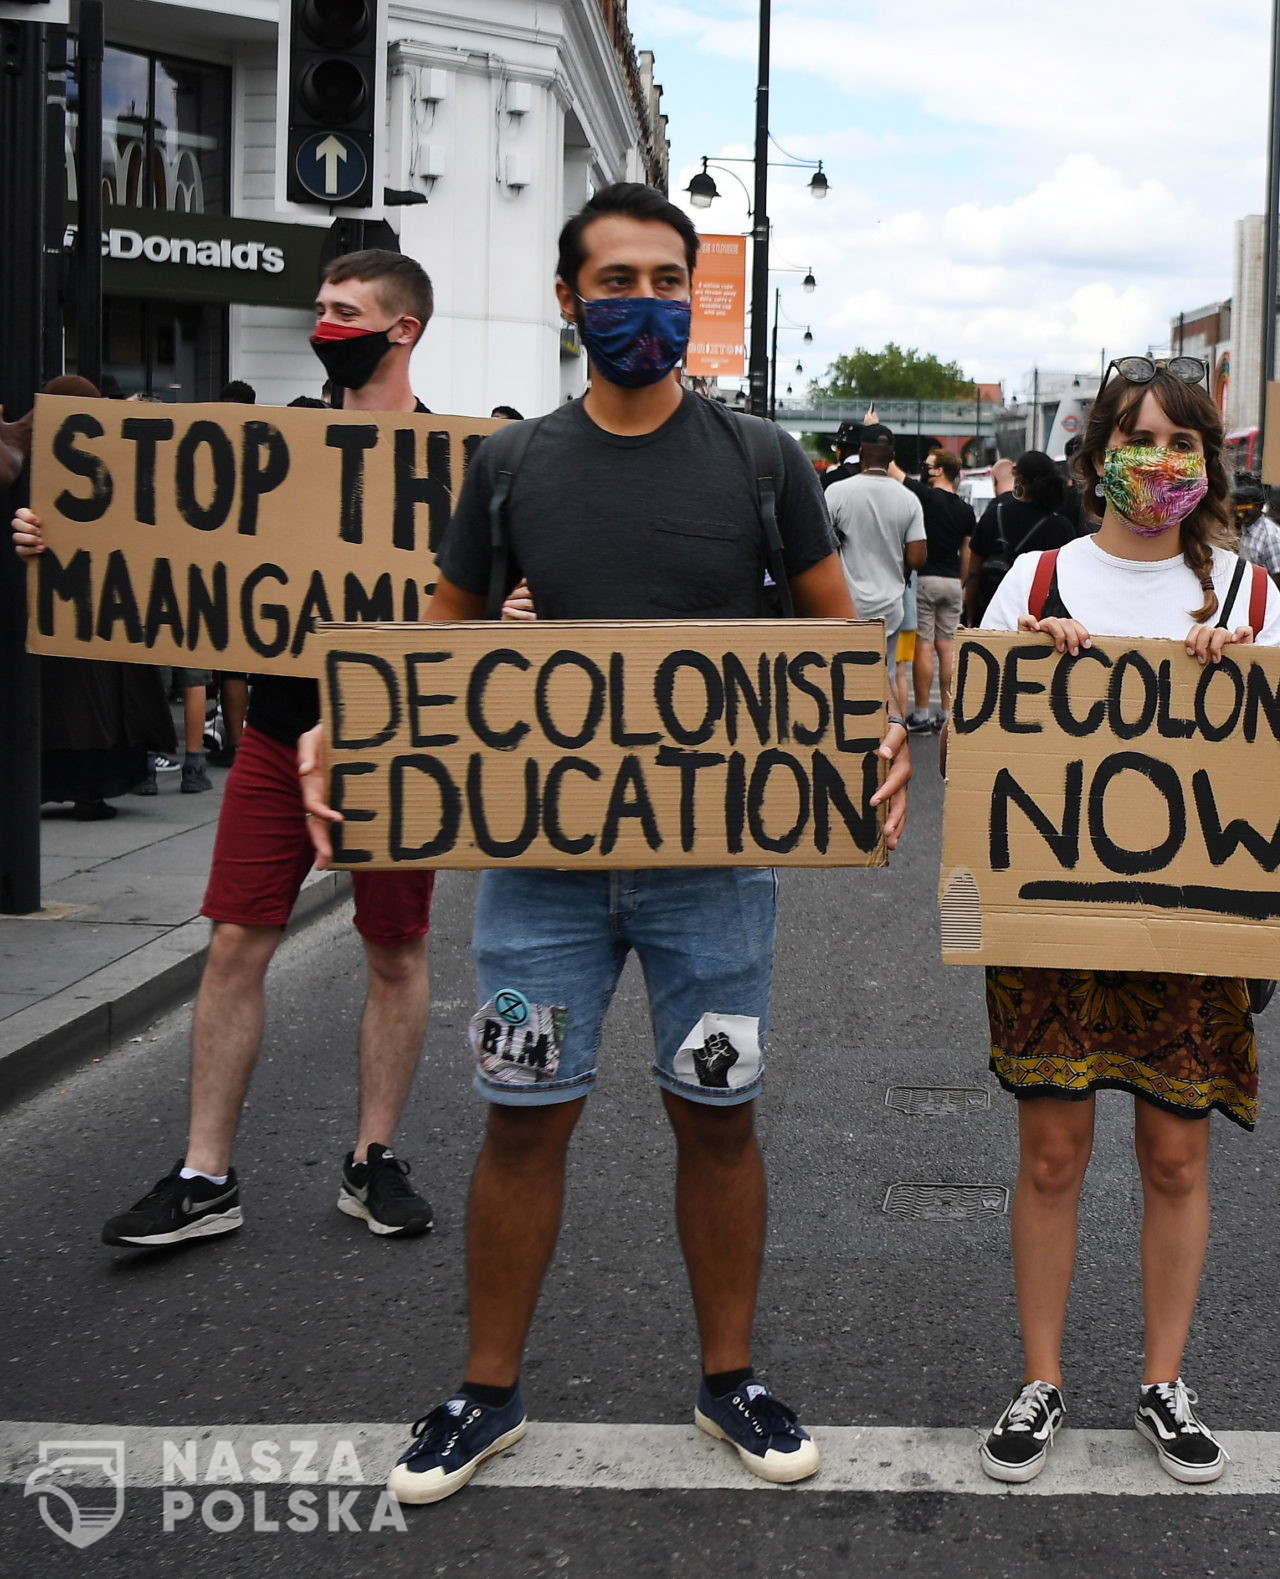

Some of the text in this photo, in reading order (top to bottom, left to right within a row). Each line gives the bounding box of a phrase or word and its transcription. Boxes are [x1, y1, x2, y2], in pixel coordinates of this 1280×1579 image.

[63, 224, 285, 273] Donald's
[53, 414, 489, 553] STOP TH
[37, 547, 438, 658] MAANGAMI
[325, 648, 882, 752] DECOLONISE
[330, 746, 879, 863] EDUCATION
